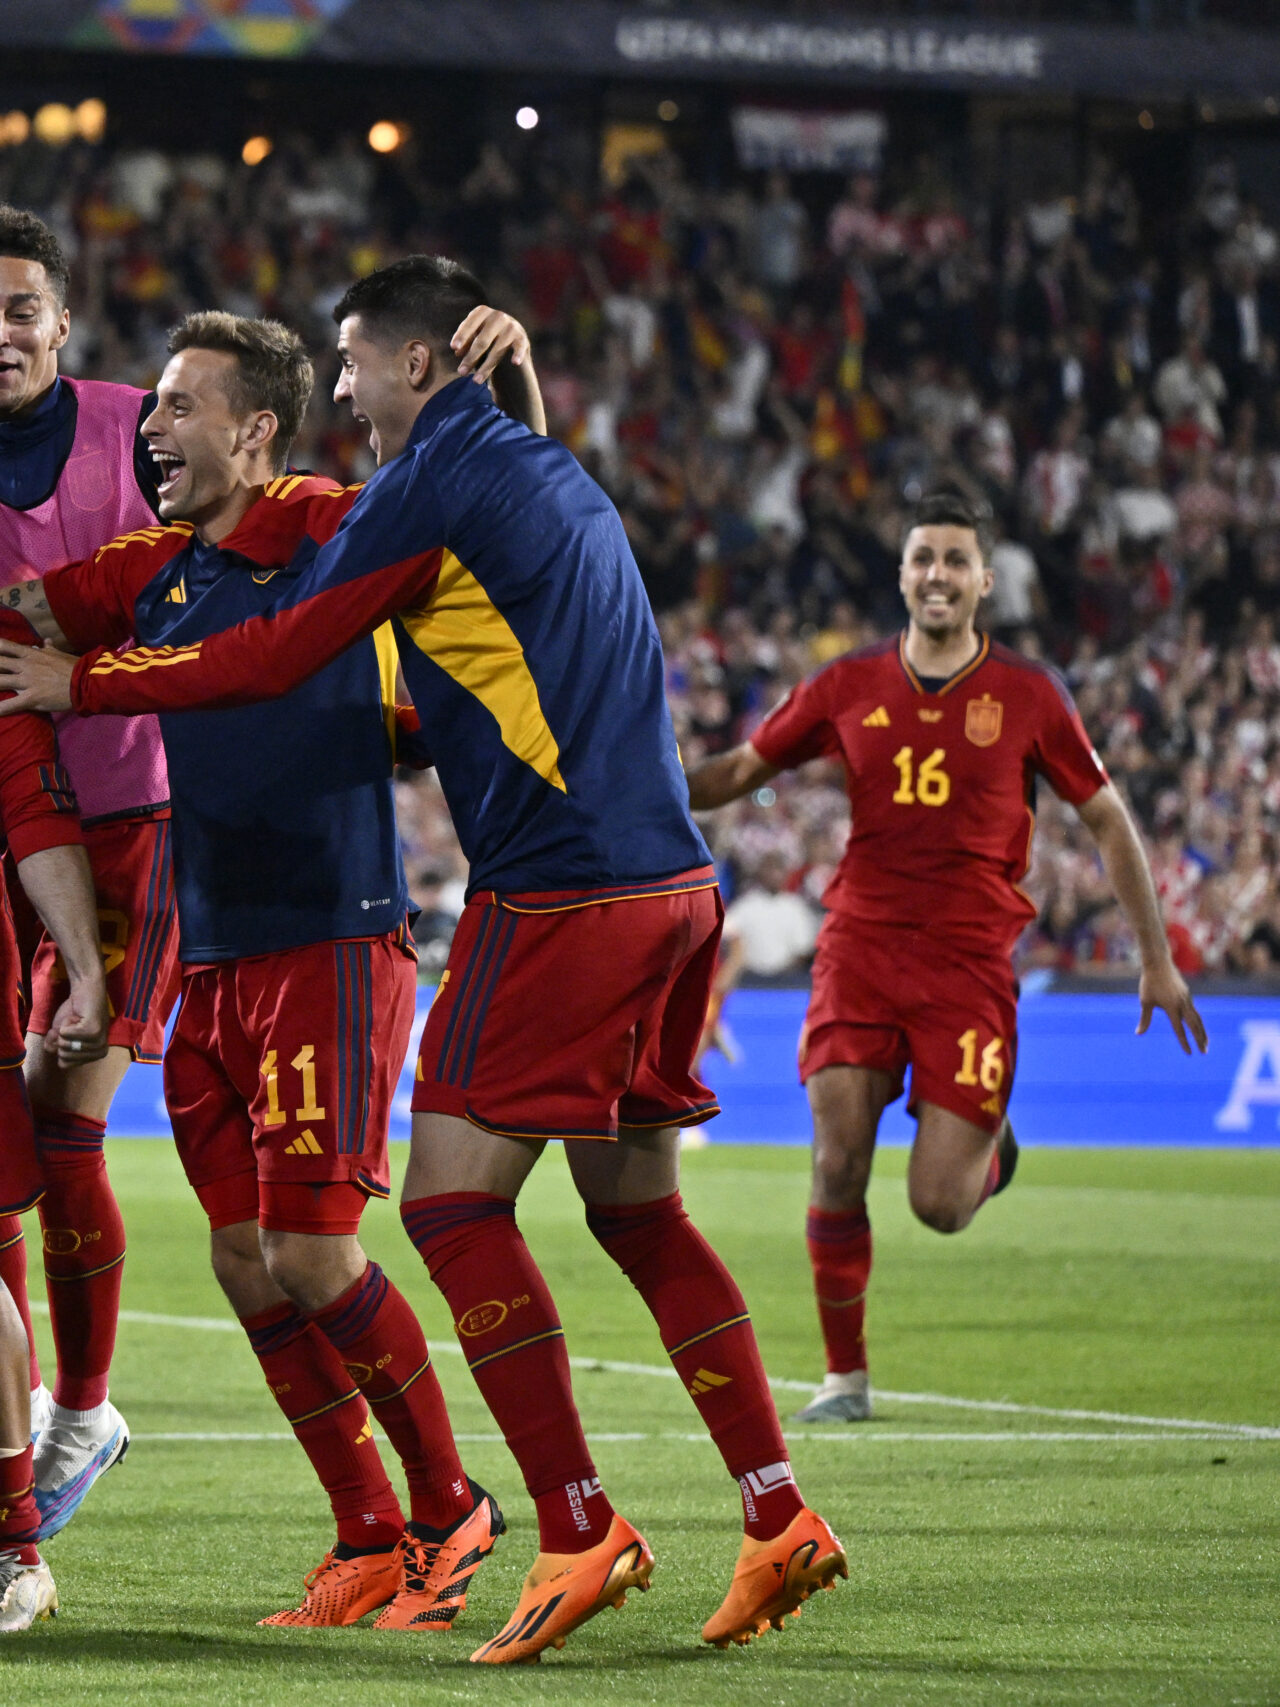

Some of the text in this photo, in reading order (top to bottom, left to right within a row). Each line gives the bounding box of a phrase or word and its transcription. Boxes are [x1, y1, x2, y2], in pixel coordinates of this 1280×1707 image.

[893, 746, 950, 807] 16
[261, 1044, 325, 1126] 11
[954, 1029, 1005, 1092] 16
[565, 1481, 591, 1531] DESIGN
